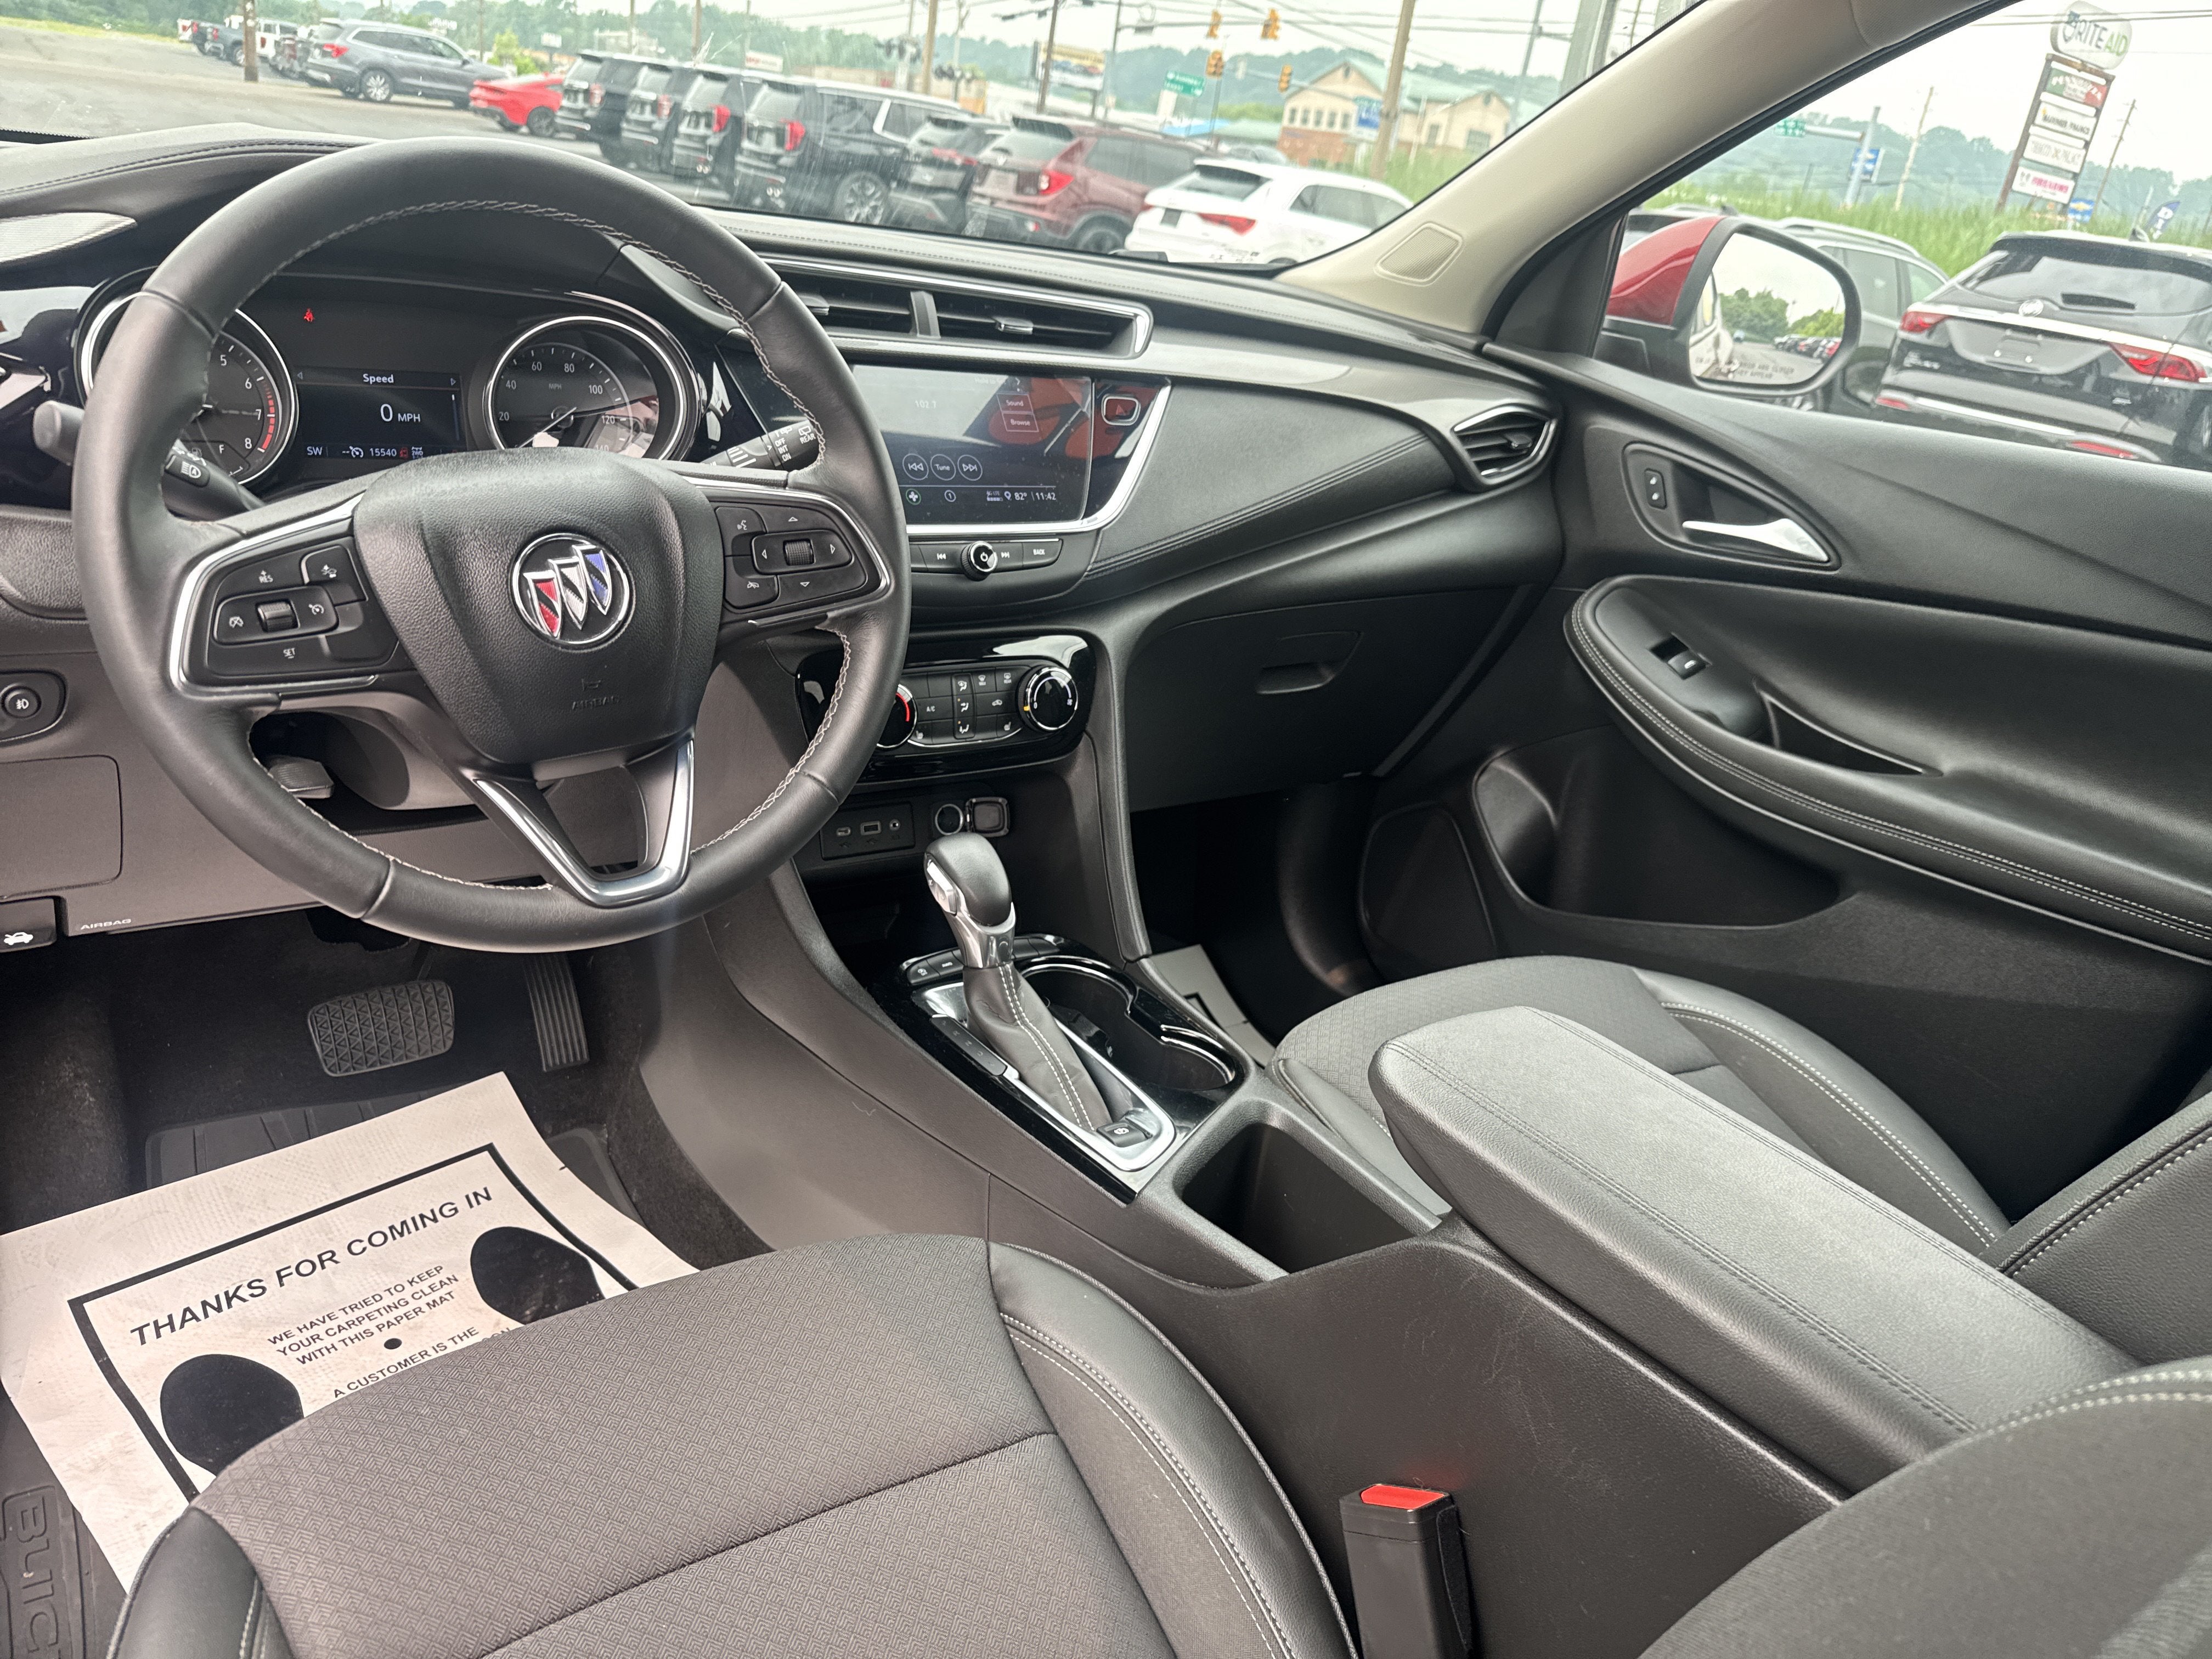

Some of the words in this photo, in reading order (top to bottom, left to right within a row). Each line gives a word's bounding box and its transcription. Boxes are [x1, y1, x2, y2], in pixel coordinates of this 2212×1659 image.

[2104, 31, 2128, 56] AID
[220, 354, 227, 366] 5
[532, 362, 542, 371] 60
[564, 363, 575, 373] 80
[245, 377, 252, 389] 6
[363, 374, 394, 384] Speed
[506, 380, 516, 390] 40
[588, 385, 603, 395] 100
[915, 400, 936, 409] 102.7
[256, 409, 262, 420] 7
[380, 404, 393, 421] 0
[398, 413, 421, 422] MPH
[499, 412, 510, 421] 20
[601, 415, 615, 425] 120
[245, 438, 252, 449] 8
[775, 438, 785, 447] OFF
[800, 433, 816, 444] REAR
[219, 444, 224, 454] F
[307, 446, 323, 456] SW
[370, 448, 397, 456] 15540
[778, 445, 788, 454] INT
[782, 453, 792, 461] ON
[1035, 492, 1056, 500] 11:42
[258, 575, 273, 584] RES
[283, 647, 296, 657] SET
[80, 918, 132, 930] AIRBAG
[130, 1278, 267, 1346] THANKS
[275, 1250, 341, 1288] FOR
[347, 1202, 459, 1256] COMING
[465, 1187, 492, 1209] IN
[267, 1330, 295, 1345] WE
[296, 1312, 338, 1333] HAVE
[338, 1293, 383, 1315] TRIED
[383, 1284, 405, 1296] TO
[407, 1266, 443, 1286] KEEP
[276, 1334, 324, 1356] YOUR
[325, 1298, 409, 1336] CARPETING
[411, 1274, 459, 1300] CLEAN
[296, 1343, 338, 1365] WITH
[338, 1329, 374, 1347] THIS
[376, 1306, 426, 1333] PAPER
[426, 1290, 455, 1309] MAT
[334, 1389, 346, 1398] A
[347, 1350, 433, 1391] CUSTOMER
[431, 1342, 448, 1354] IS
[448, 1327, 479, 1345] THE
[16, 1496, 61, 1659] BUIC
